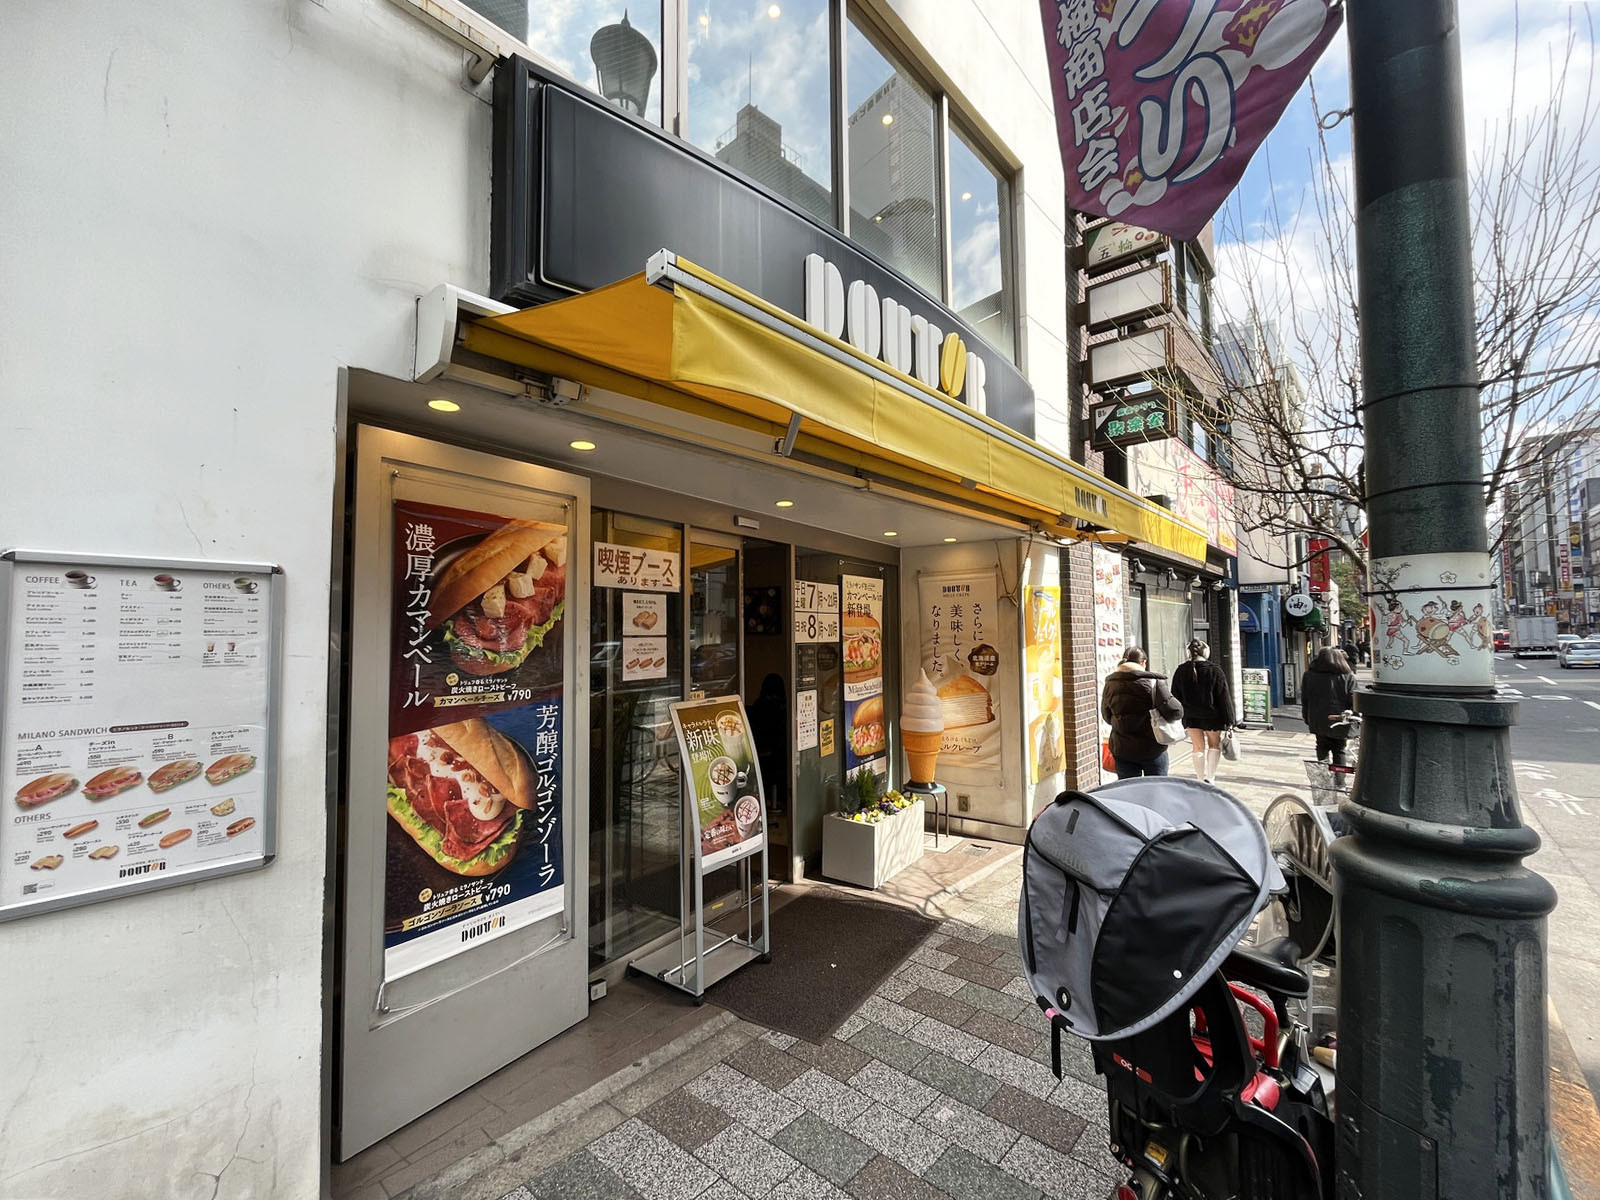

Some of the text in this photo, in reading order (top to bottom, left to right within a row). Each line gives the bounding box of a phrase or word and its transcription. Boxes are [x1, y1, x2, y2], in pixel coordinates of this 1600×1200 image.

[804, 252, 986, 417] DOUTOR
[598, 547, 675, 577] 喫煙ブース
[25, 575, 61, 584] COFFEE
[119, 579, 138, 587] TEA
[203, 582, 231, 590] OTHERS
[616, 575, 661, 588] あります
[403, 522, 436, 709] 濃厚カマンベール
[972, 603, 984, 641] さらに
[507, 689, 532, 701] ¥790
[18, 730, 55, 740] MILANO
[59, 726, 108, 737] SANDWICH
[686, 725, 720, 752] 新味
[940, 743, 982, 753] ルクレープ
[536, 704, 560, 887] 芳醇ゴルゴンゾーラ
[14, 813, 51, 824] OTHERS
[119, 861, 166, 879] DOUTOR
[485, 884, 511, 902] ¥790
[461, 915, 506, 943] DOUTOR
